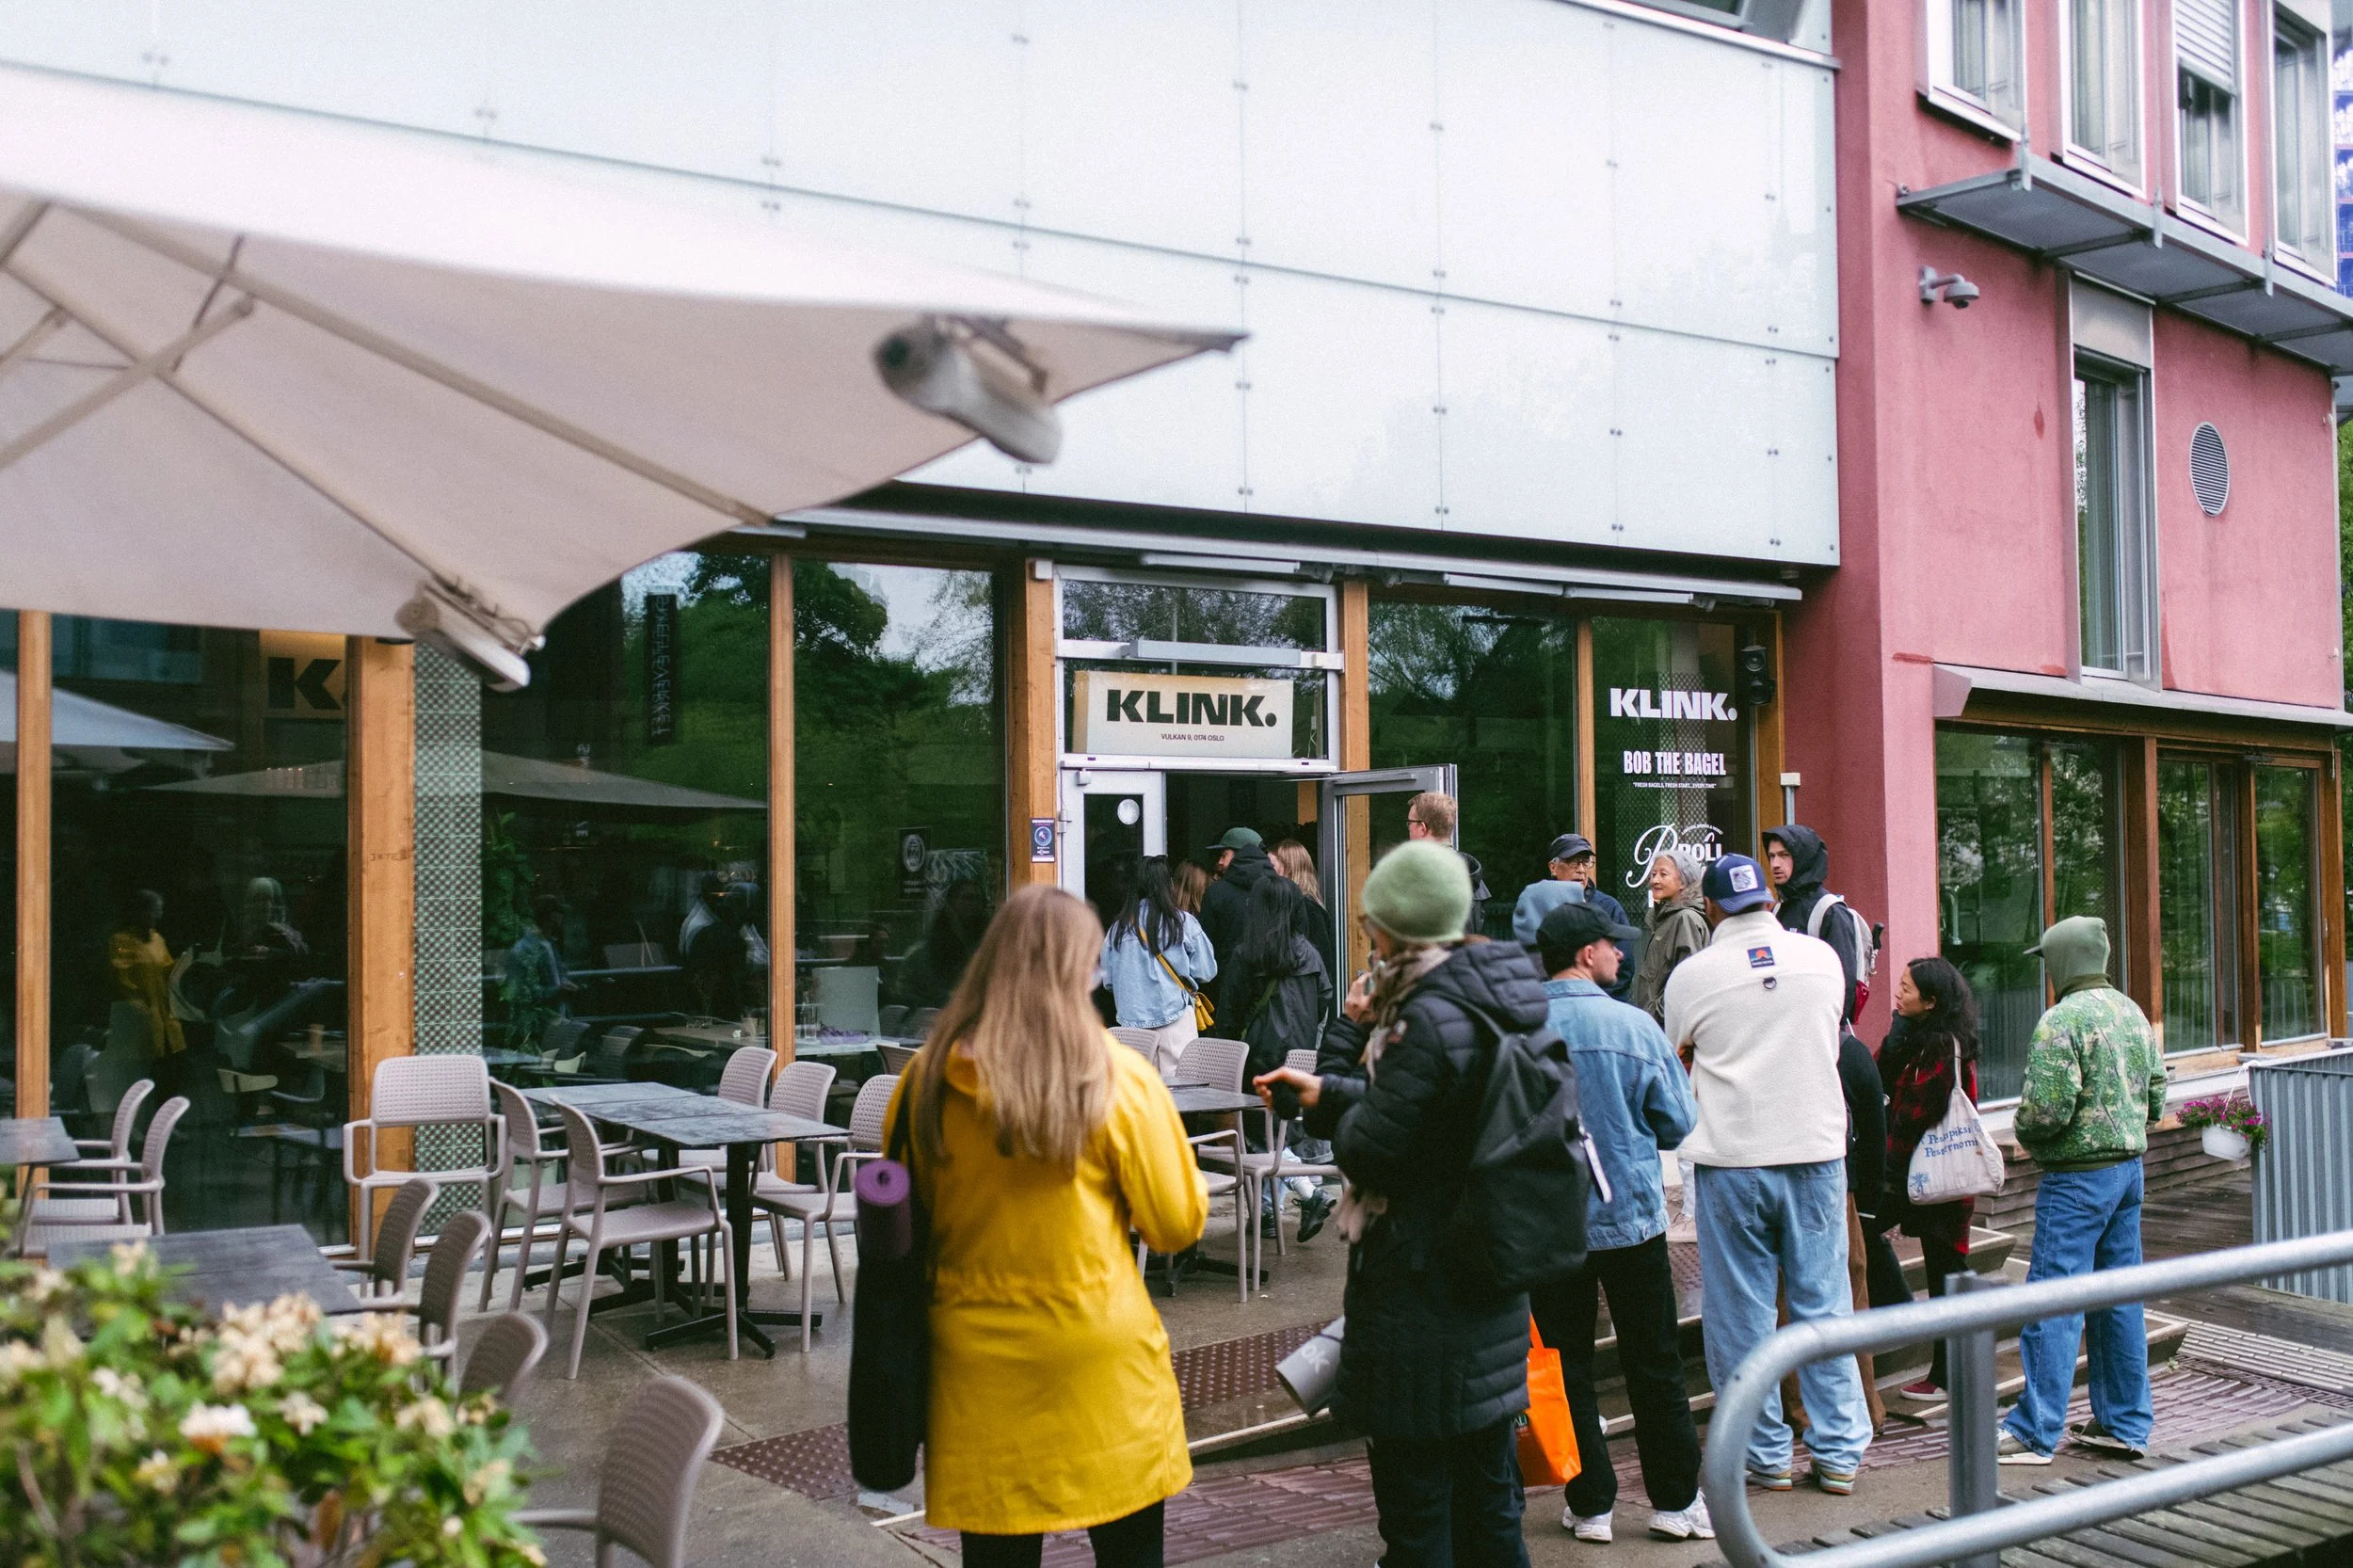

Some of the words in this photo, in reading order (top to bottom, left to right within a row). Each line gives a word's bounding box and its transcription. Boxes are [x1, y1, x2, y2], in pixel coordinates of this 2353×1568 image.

[1107, 689, 1277, 727] KLINK.
[1609, 687, 1737, 721] KLINK.
[1624, 750, 1652, 775] BOB
[1655, 751, 1681, 776] THE
[1684, 752, 1726, 776] BAGEL
